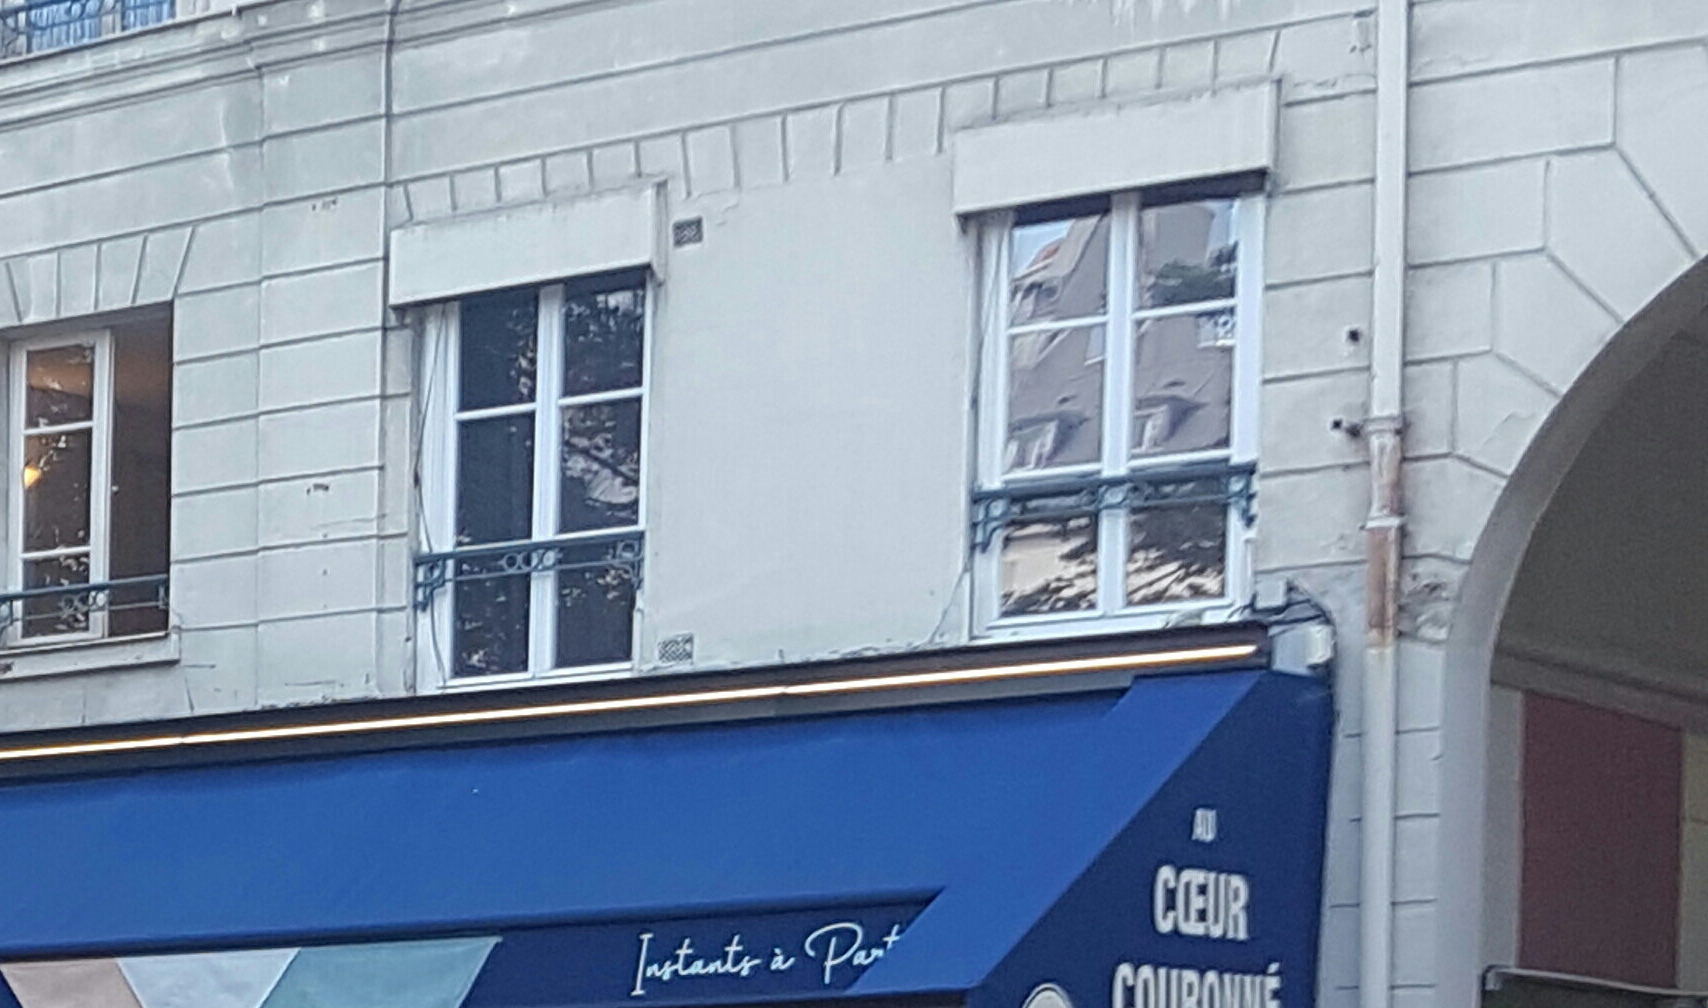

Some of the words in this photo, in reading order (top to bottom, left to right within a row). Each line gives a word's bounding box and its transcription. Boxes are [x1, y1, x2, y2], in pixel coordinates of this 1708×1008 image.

[630, 932, 762, 997] Instants
[769, 947, 795, 972] à
[803, 921, 901, 985] Part
